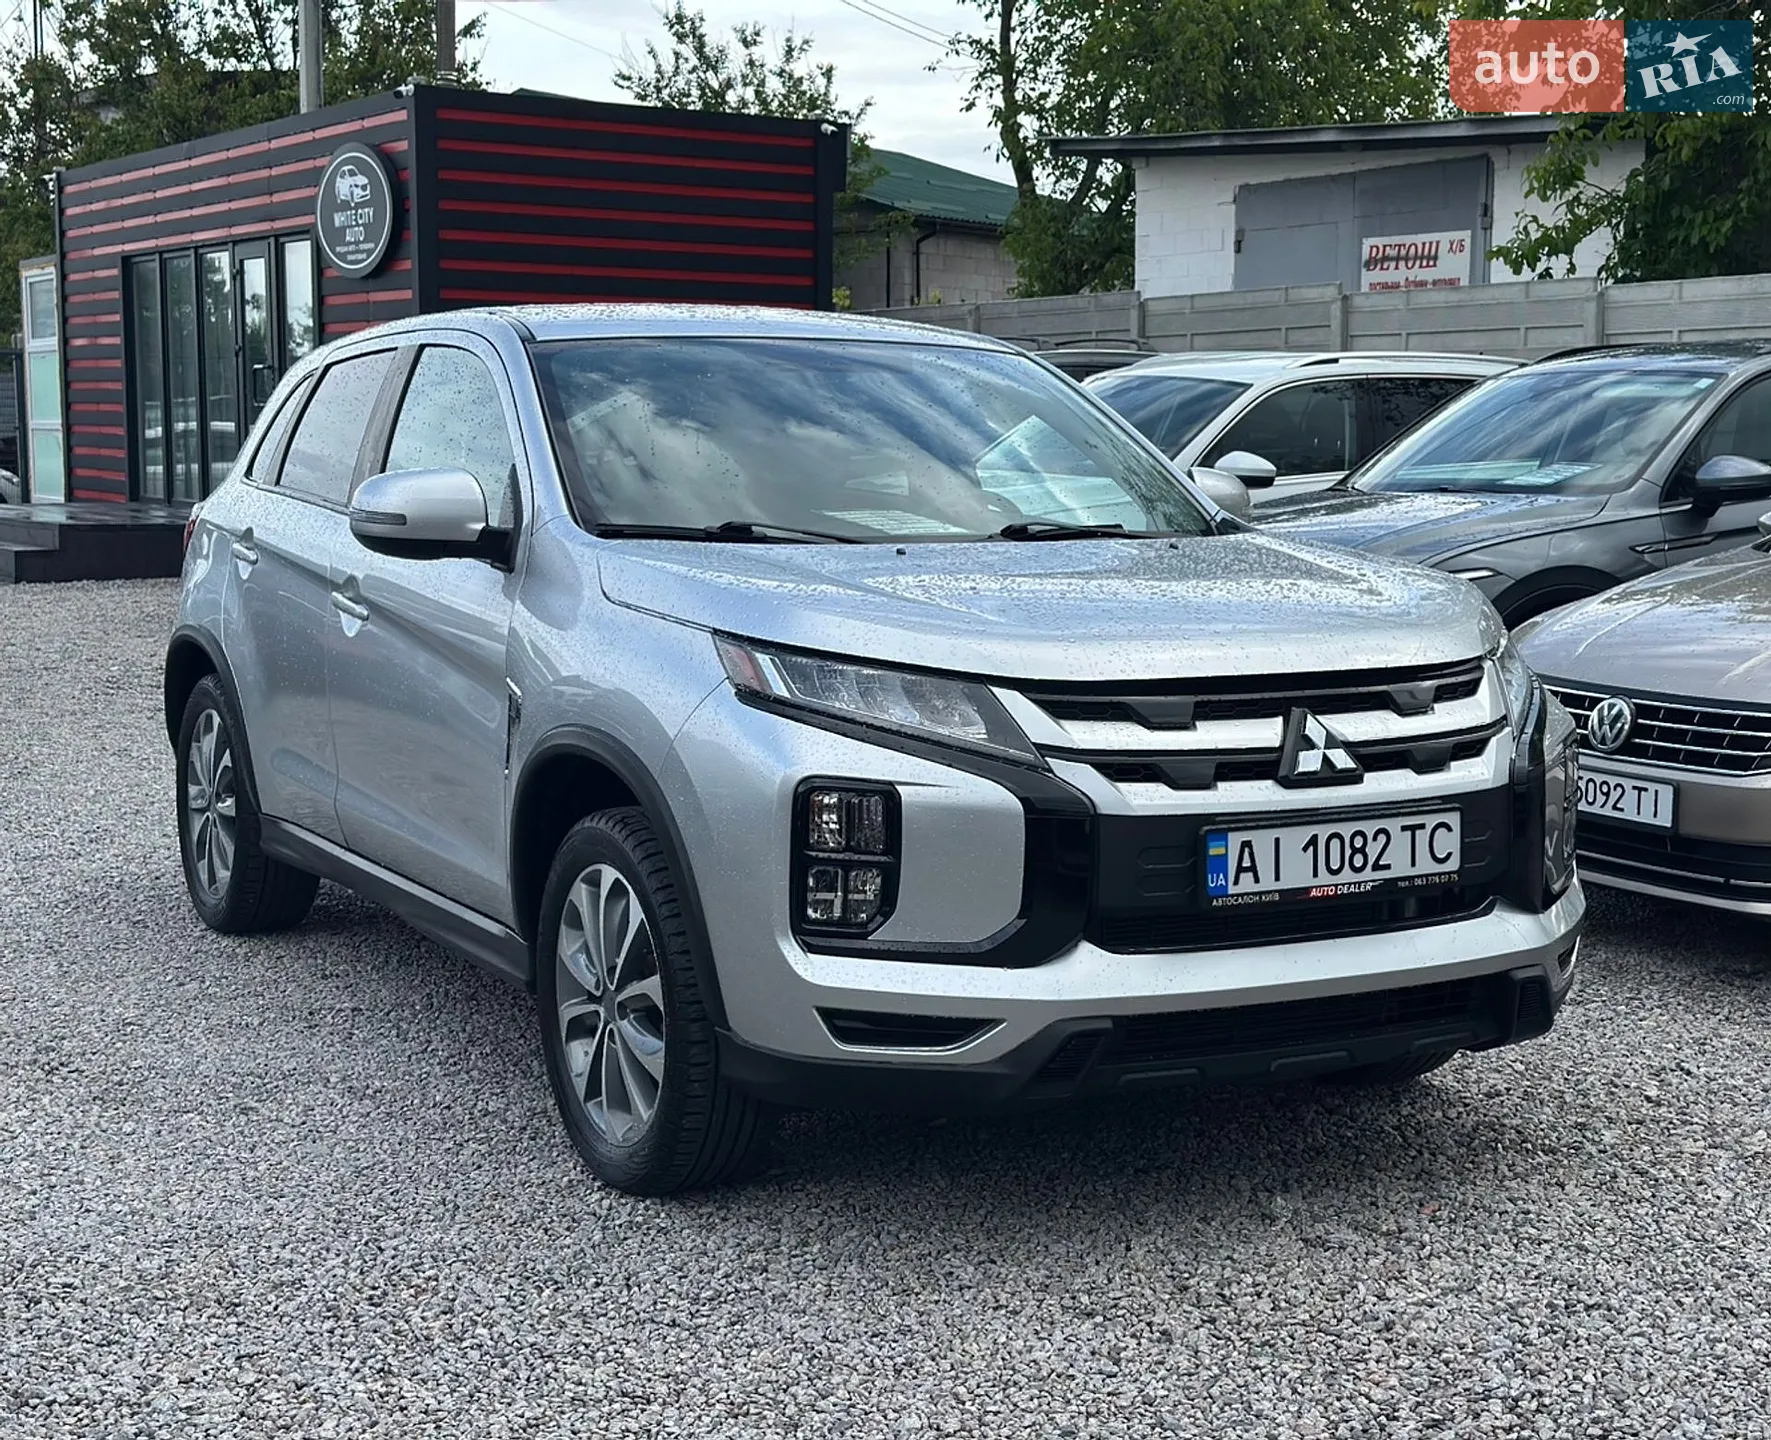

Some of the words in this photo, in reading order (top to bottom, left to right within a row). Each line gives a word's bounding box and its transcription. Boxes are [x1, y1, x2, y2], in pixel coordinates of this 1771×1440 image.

[334, 210, 356, 228] WHITE
[357, 207, 374, 225] CITY
[345, 226, 365, 242] AUTO
[1631, 785, 1659, 819] TI
[1232, 836, 1281, 887] AI
[1301, 827, 1392, 879] 1082
[1400, 821, 1454, 868] TC
[1208, 873, 1226, 887] UA
[1309, 885, 1336, 898] AUTO
[1336, 881, 1373, 895] DEALER
